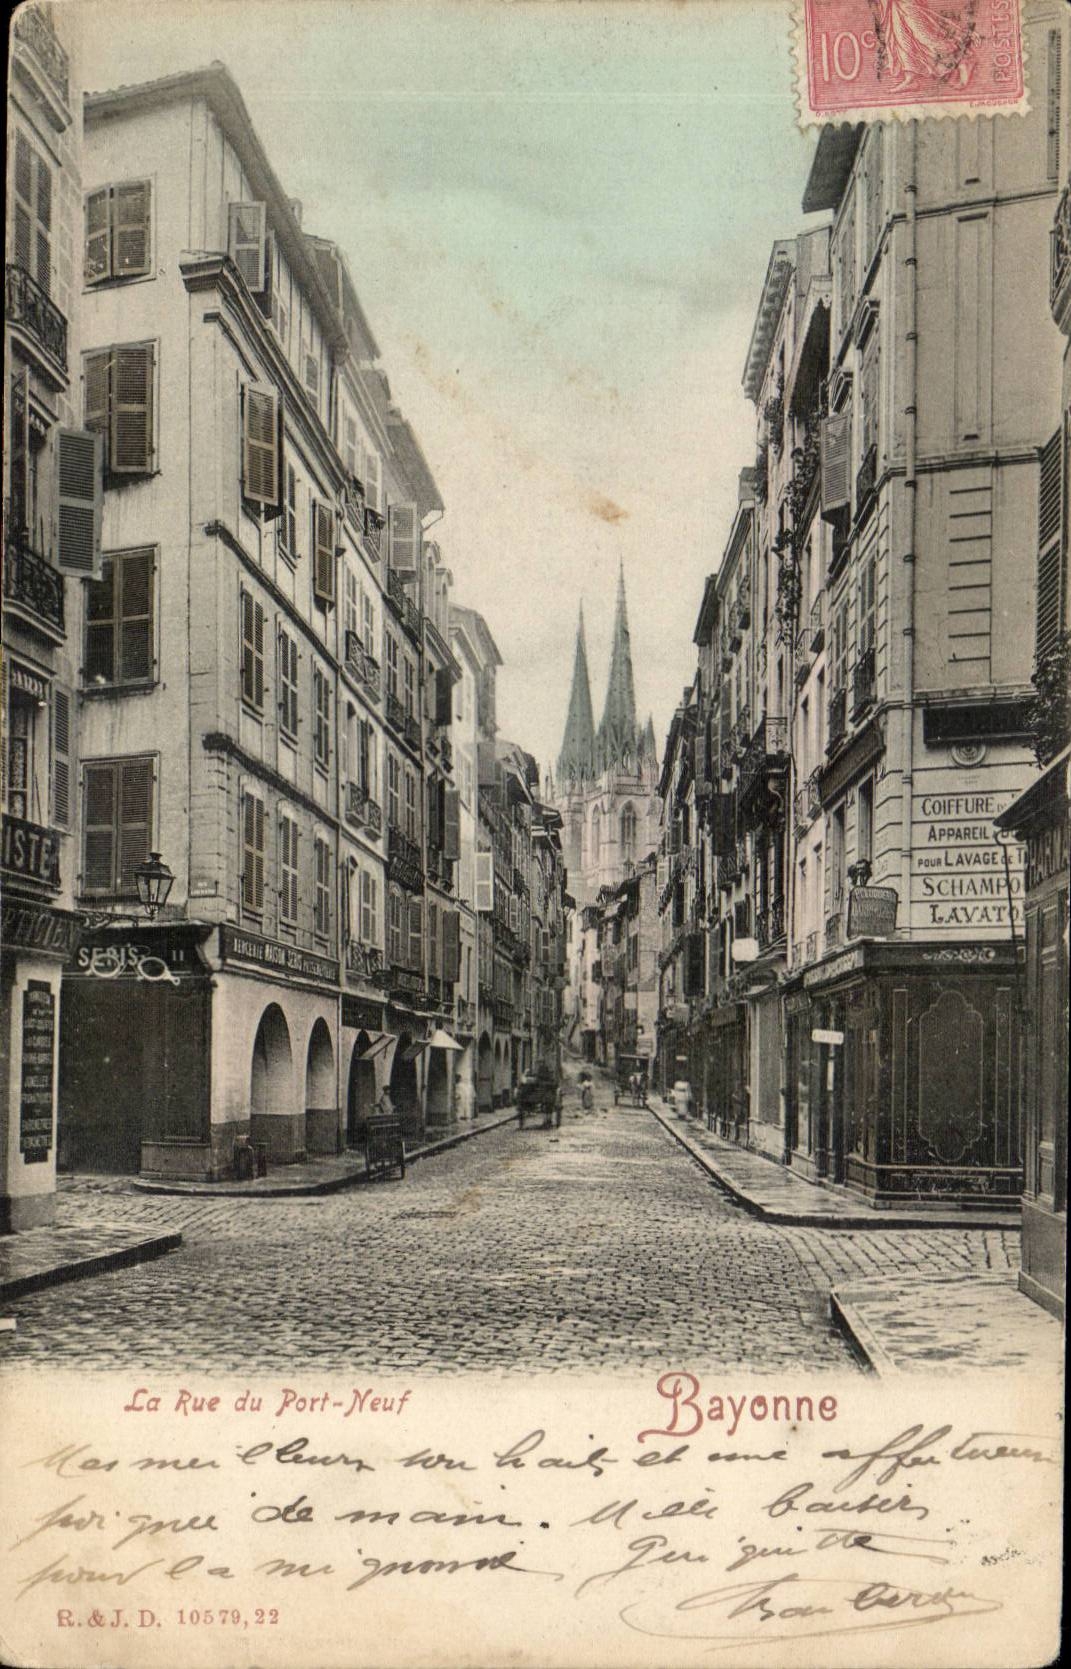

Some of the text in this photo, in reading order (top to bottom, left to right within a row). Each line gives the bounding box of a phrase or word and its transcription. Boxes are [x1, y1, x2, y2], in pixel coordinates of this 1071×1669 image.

[922, 797, 995, 816] COIFFURE
[928, 825, 990, 842] APPAREIL
[945, 850, 999, 867] LAVAGE
[922, 876, 1020, 897] SCHAMPO
